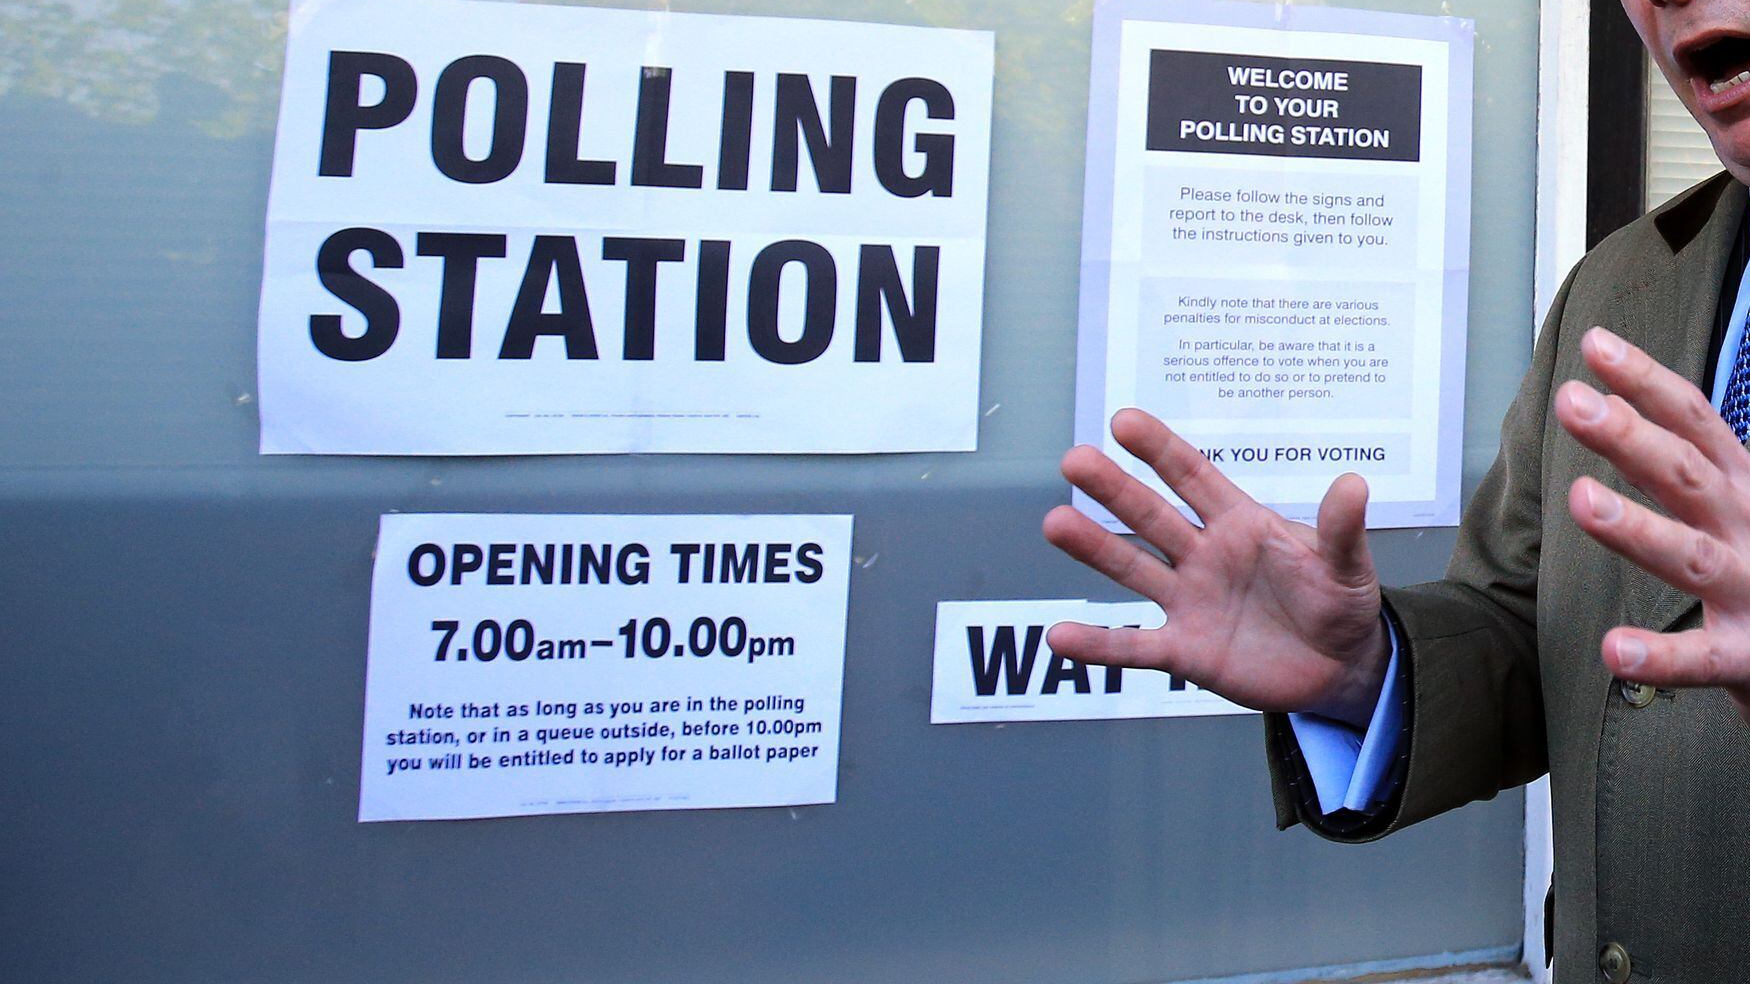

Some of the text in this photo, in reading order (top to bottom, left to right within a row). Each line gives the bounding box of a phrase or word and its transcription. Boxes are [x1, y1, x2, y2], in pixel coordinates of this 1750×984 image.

[1227, 66, 1349, 91] WELCOME
[1234, 95, 1339, 118] TO YOUR
[318, 49, 956, 198] POLLING
[1180, 120, 1390, 148] POLLING STATION
[1180, 187, 1384, 209] Please follow the signs and
[1169, 208, 1393, 226] report to the desk, then follow
[1172, 227, 1388, 248] the instructions given to you.
[309, 227, 941, 365] STATION
[1178, 296, 1379, 310] Kindly note that there are various
[1164, 313, 1390, 326] penalties for misconduct at elections.
[1179, 340, 1375, 352] In particular, be aware that it is a
[1163, 356, 1388, 369] serious offence to vote when you are
[1165, 372, 1386, 385] not entitled to do so or to pretend to
[1218, 388, 1334, 400] be another person.
[1231, 448, 1269, 461] YOU
[1275, 448, 1311, 461] FOR
[1318, 447, 1385, 461] VOTING
[408, 542, 824, 586] OPENING TIMES
[409, 696, 804, 719] Note that as long as you are in the polling
[386, 720, 822, 747] station, or in a queue outside, before 10.00pm
[387, 745, 818, 775] you will be entitled to apply for a ballot paper
